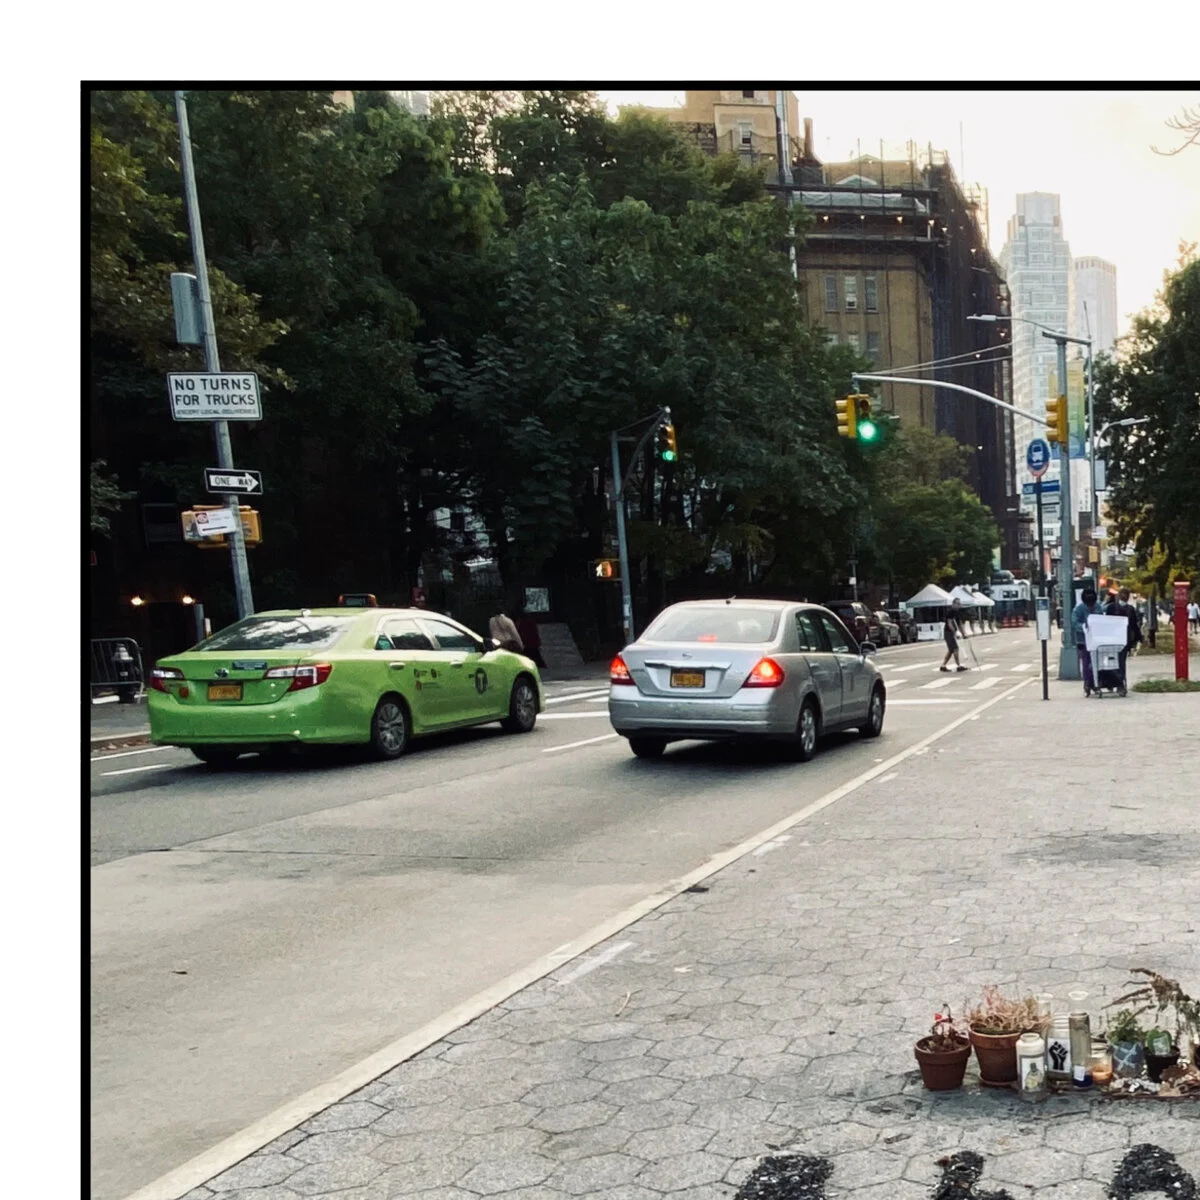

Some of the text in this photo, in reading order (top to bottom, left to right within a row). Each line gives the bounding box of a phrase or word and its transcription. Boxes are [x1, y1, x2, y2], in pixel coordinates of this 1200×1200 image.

[174, 378, 252, 390] NO TURNS
[175, 394, 256, 405] FOR TRUCKS
[214, 476, 254, 487] ONE WAY
